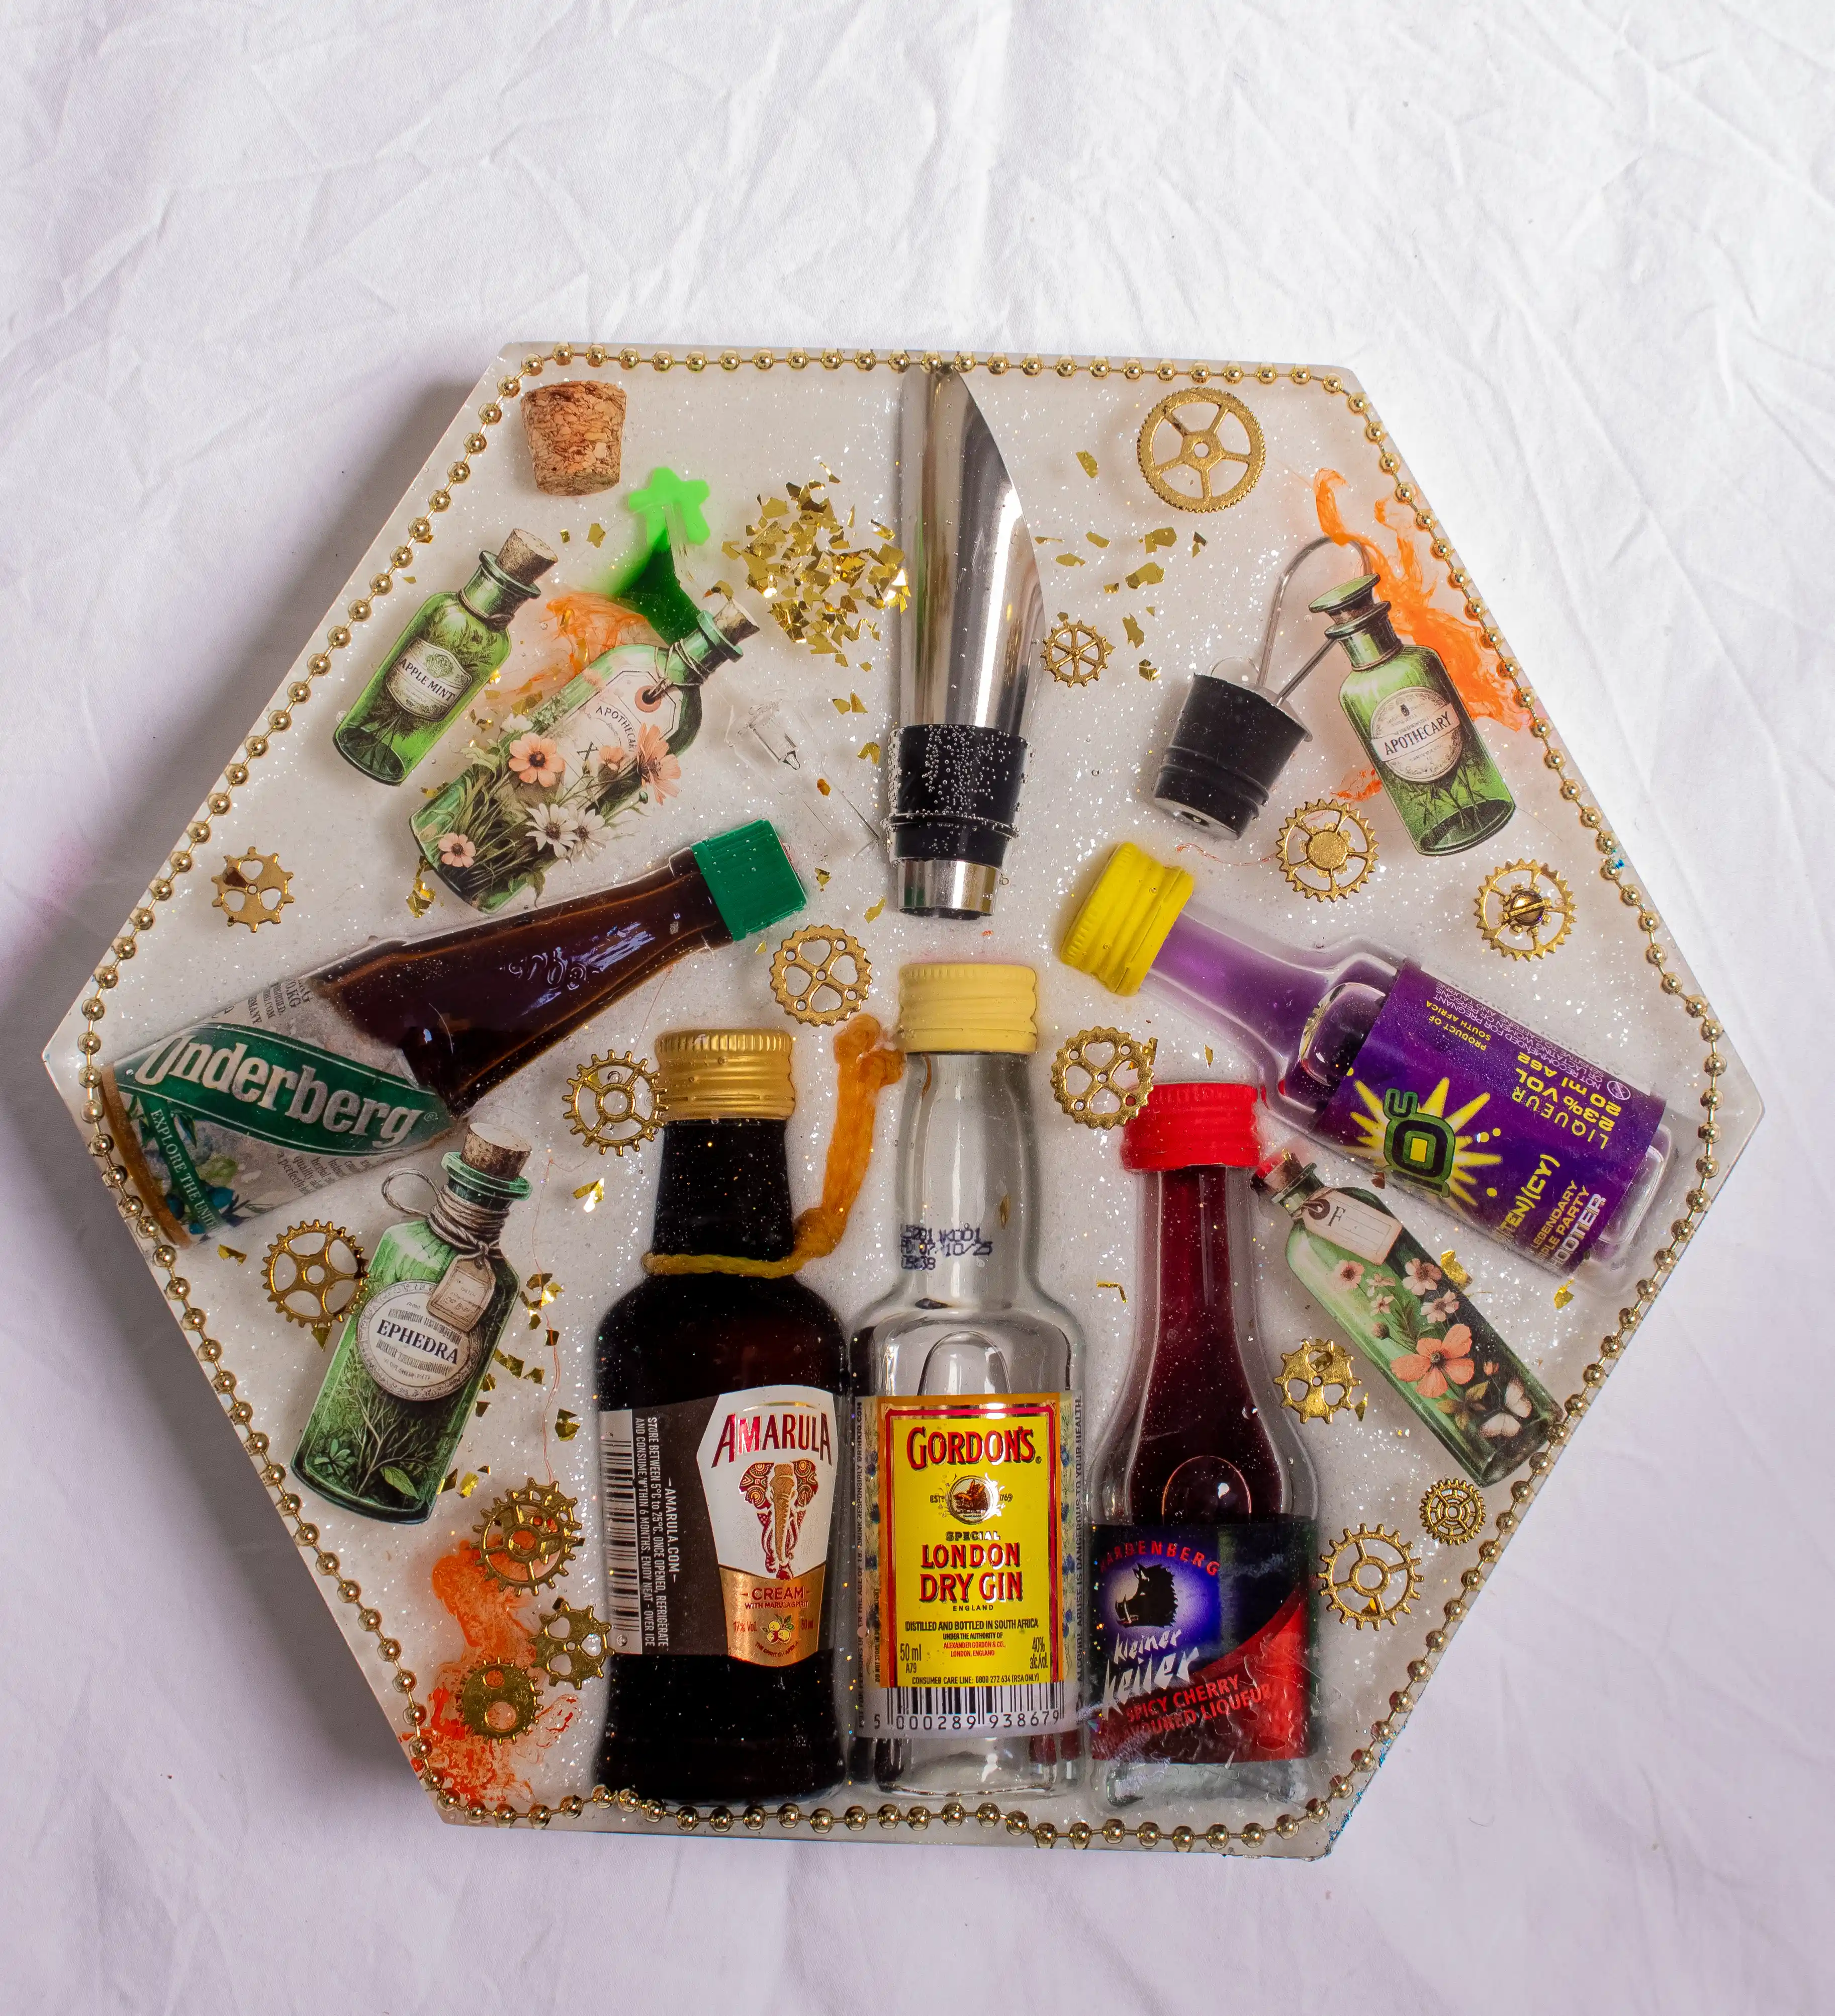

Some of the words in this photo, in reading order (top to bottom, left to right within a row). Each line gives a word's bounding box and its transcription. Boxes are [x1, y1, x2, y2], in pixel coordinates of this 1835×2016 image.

[399, 658, 427, 685] APPLE
[427, 680, 455, 702] MINT
[1426, 1001, 1459, 1021] AFRICA
[1433, 994, 1483, 1024] PREGNANT
[1435, 987, 1479, 1015] PERSONS
[1428, 1015, 1441, 1025] OF
[1479, 1011, 1495, 1023] OR
[1484, 1022, 1504, 1036] FOR
[1443, 1023, 1487, 1050] PRODUCT
[1460, 1021, 1491, 1040] SOUTH
[1495, 1019, 1535, 1045] WOMEN
[1503, 1031, 1579, 1078] RECOMMENDED
[1517, 1052, 1557, 1077] A62
[1534, 1041, 1588, 1075] LACTATING
[1511, 1067, 1563, 1103] VOL
[1560, 1076, 1588, 1097] ml
[1578, 1073, 1601, 1090] NOT
[1586, 1070, 1603, 1083] OR
[135, 1035, 425, 1149] Underberg
[1588, 1091, 1622, 1117] 20
[1509, 1085, 1609, 1150] LIQUEUR
[1561, 1095, 1615, 1132] 23%
[150, 1108, 187, 1174] EXPLORE
[178, 1172, 202, 1201] THE
[293, 1156, 314, 1180] quality
[1328, 1206, 1346, 1226] F
[1556, 1186, 1589, 1235] PARTY
[377, 1319, 458, 1365] EPHEDRA
[634, 1418, 646, 1434] AND
[647, 1417, 658, 1442] STORE
[711, 1412, 832, 1468] AMARULA
[906, 1426, 1036, 1471] GORDON'S
[635, 1436, 647, 1475] CONSUME
[649, 1444, 660, 1481] BETWEEN
[650, 1483, 661, 1499] 5°C
[999, 1494, 1013, 1502] 1769
[1076, 1481, 1082, 1496] TO
[651, 1500, 661, 1510] to
[651, 1512, 663, 1534] 25°C.
[665, 1487, 679, 1572] AMARULA.COM
[638, 1517, 651, 1554] MONTHS.
[653, 1536, 664, 1557] ONCE
[945, 1530, 1000, 1541] SPECIAL
[640, 1555, 652, 1580] ENJOY
[921, 1542, 1021, 1569] LONDON
[652, 1559, 665, 1593] OPENED,
[857, 1564, 863, 1575] OF
[1076, 1573, 1082, 1585] IS
[641, 1582, 653, 1602] NEAT
[752, 1586, 804, 1601] CREAM
[919, 1573, 974, 1603] DRY
[979, 1571, 1024, 1603] GIN
[643, 1610, 655, 1631] OVER
[655, 1595, 668, 1646] REFRIGERATE
[733, 1621, 745, 1632] 17%
[905, 1621, 937, 1631] DISTILLED
[938, 1621, 953, 1631] AND
[955, 1620, 984, 1630] BOTTLED
[986, 1620, 993, 1629] IN
[994, 1619, 1016, 1629] SOUTH
[1017, 1618, 1039, 1628] AFRICA
[644, 1633, 655, 1646] ICE
[1032, 1636, 1045, 1653] 40%
[1114, 1629, 1182, 1664] kleiner
[763, 1648, 777, 1657] SPIRIT
[900, 1643, 910, 1661] 50
[911, 1643, 922, 1661] ml
[905, 1662, 917, 1674] A79
[975, 1675, 989, 1683] 0800
[990, 1675, 1000, 1683] 272
[1012, 1674, 1024, 1682] (RSA
[1025, 1673, 1039, 1681] ONLY)
[1126, 1697, 1167, 1723] SPICY
[1172, 1674, 1240, 1709] CHERRY
[1202, 1683, 1270, 1720] LIQUEUR
[873, 1714, 880, 1730] 5
[896, 1714, 977, 1730] 000289
[989, 1711, 1059, 1728] 938679
